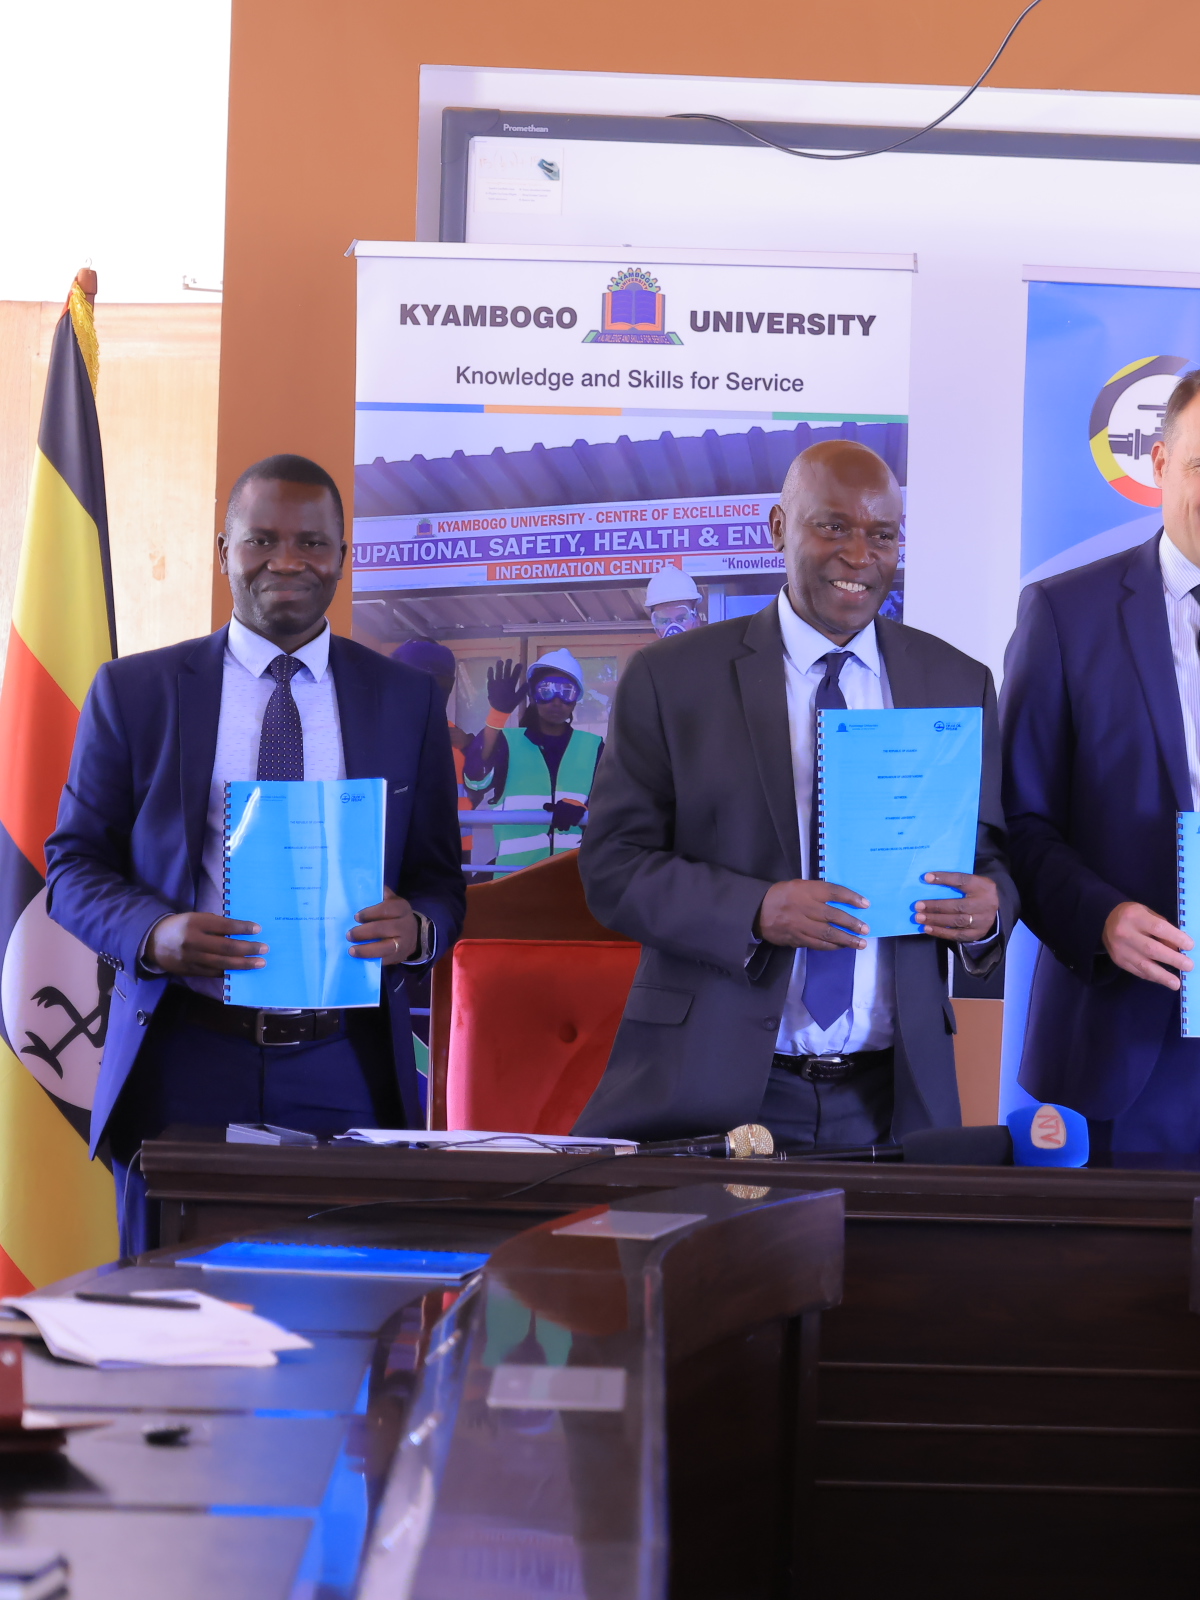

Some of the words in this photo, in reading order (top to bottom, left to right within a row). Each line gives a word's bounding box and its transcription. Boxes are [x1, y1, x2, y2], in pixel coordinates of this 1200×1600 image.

[503, 123, 549, 133] Promethean
[614, 272, 654, 288] KYAMBOGO
[399, 303, 578, 330] KYAMBOGO
[690, 310, 877, 336] UNIVERSITY
[456, 366, 574, 391] Knowledge
[581, 370, 620, 387] and
[628, 369, 684, 389] Skills
[690, 371, 719, 389] for
[726, 372, 804, 392] Service
[437, 517, 507, 533] KYAMBOGO
[510, 512, 586, 528] UNIVERSITY
[596, 509, 648, 524] CENTRE
[652, 508, 670, 521] OF
[673, 503, 760, 520] EXCELLENCE
[352, 541, 482, 564] UPATIONAL
[488, 533, 585, 557] SAFETY,
[594, 528, 690, 551] HEALTH
[698, 527, 720, 547] &
[495, 562, 605, 580] INFORMATION
[722, 556, 786, 569] “Knowledg
[1036, 1114, 1062, 1145] NTV
